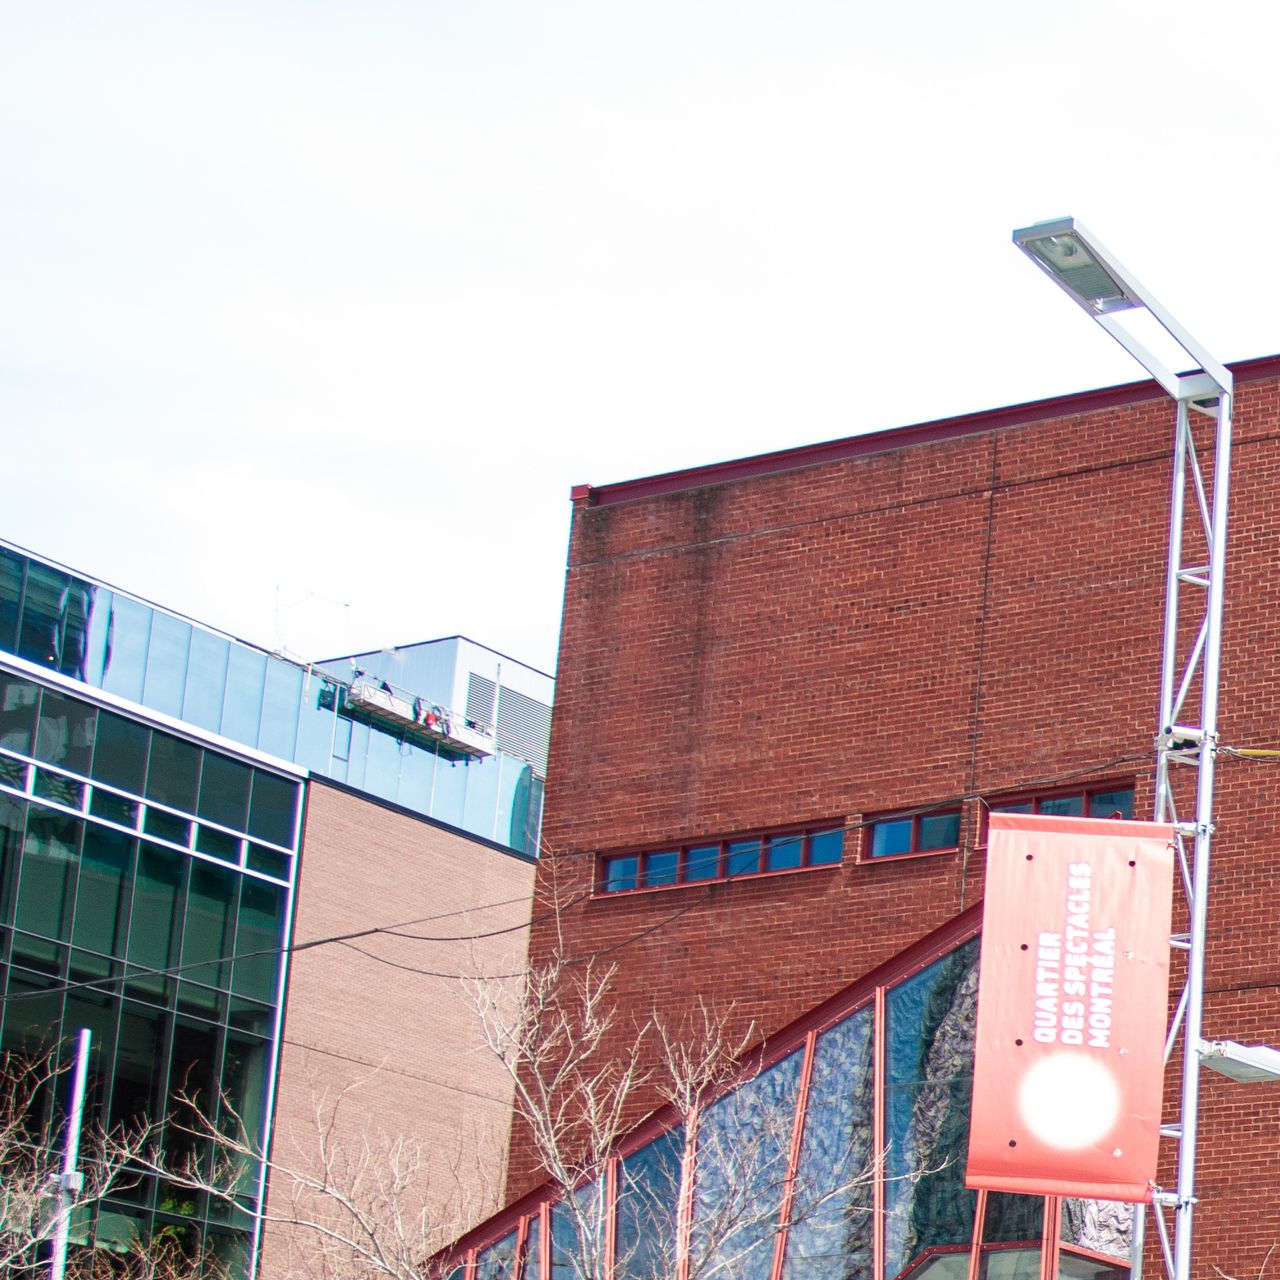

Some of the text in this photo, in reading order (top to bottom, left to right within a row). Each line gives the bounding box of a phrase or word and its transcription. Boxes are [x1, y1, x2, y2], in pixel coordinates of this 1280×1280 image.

[1034, 932, 1062, 1043] QUARTIER
[1061, 862, 1092, 1045] DES SPECTACLES
[1086, 927, 1115, 1048] MONTRÉAL
